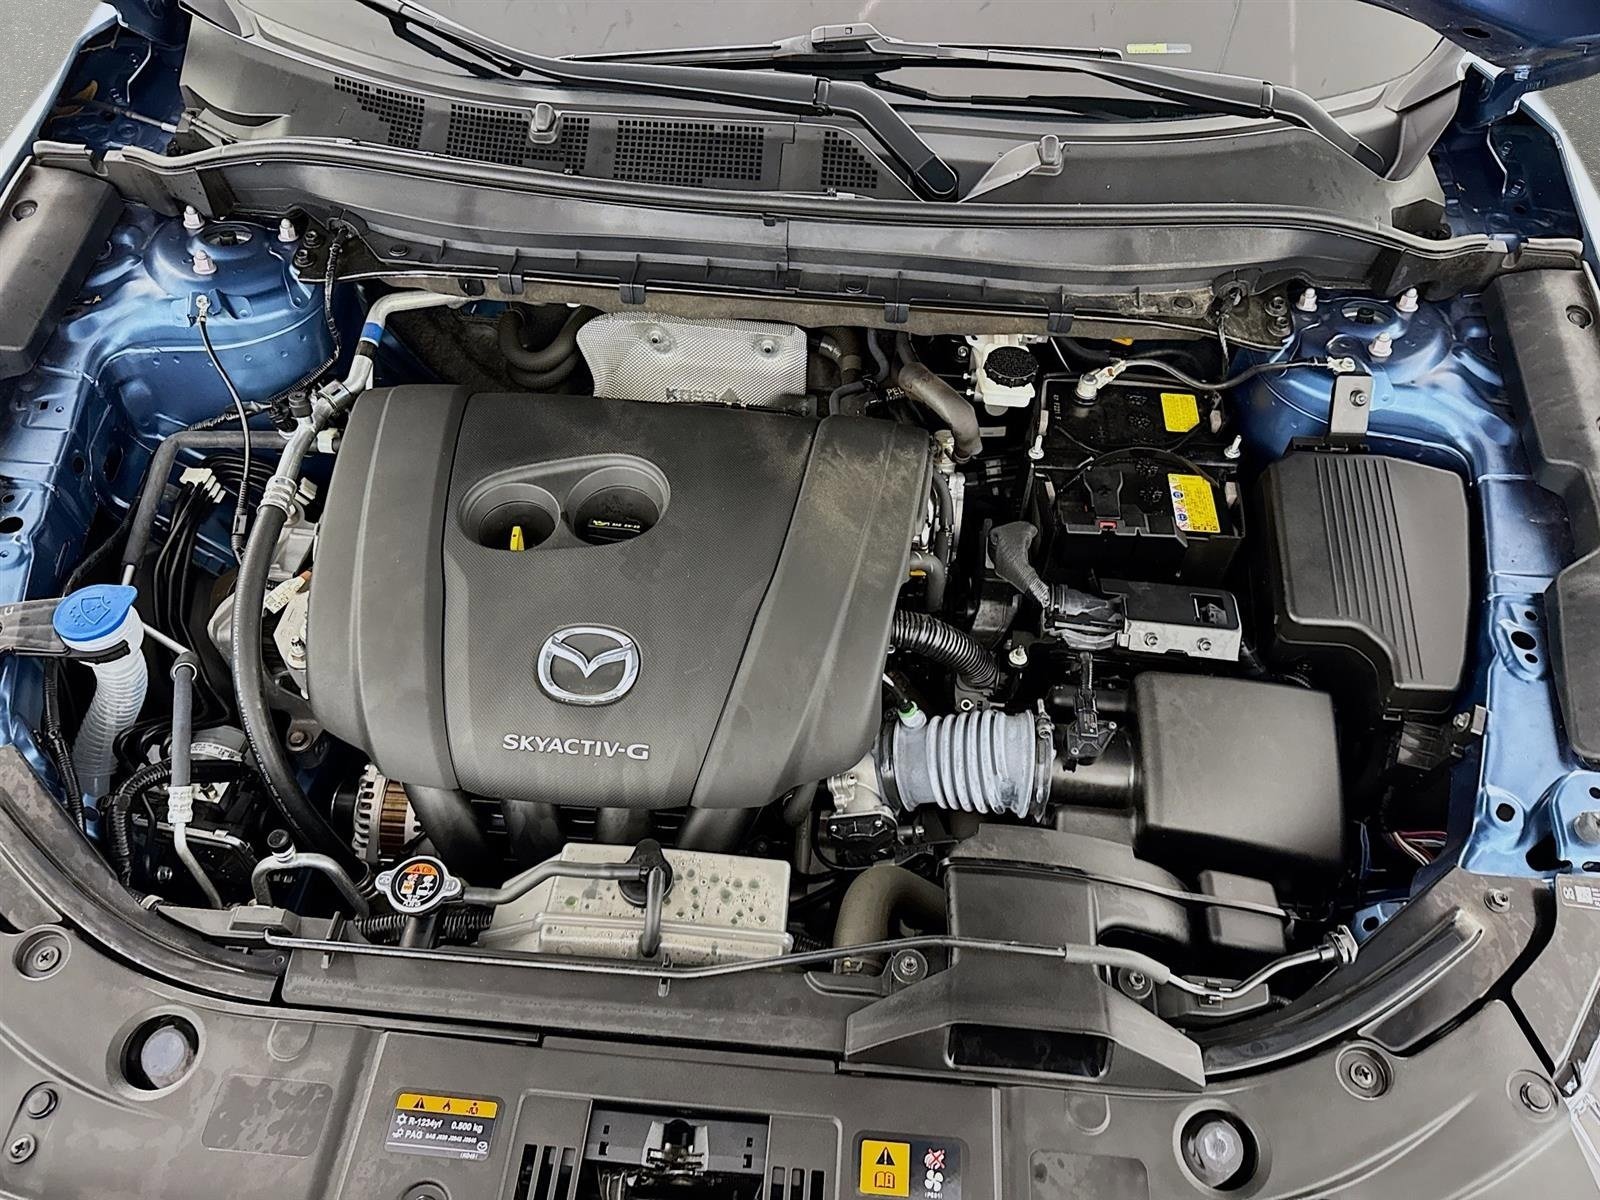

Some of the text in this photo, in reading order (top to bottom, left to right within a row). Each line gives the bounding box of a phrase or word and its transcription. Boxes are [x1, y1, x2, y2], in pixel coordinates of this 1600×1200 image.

[502, 733, 650, 760] SKYACTIV-G
[473, 1123, 484, 1134] kg
[404, 1130, 423, 1140] PAG
